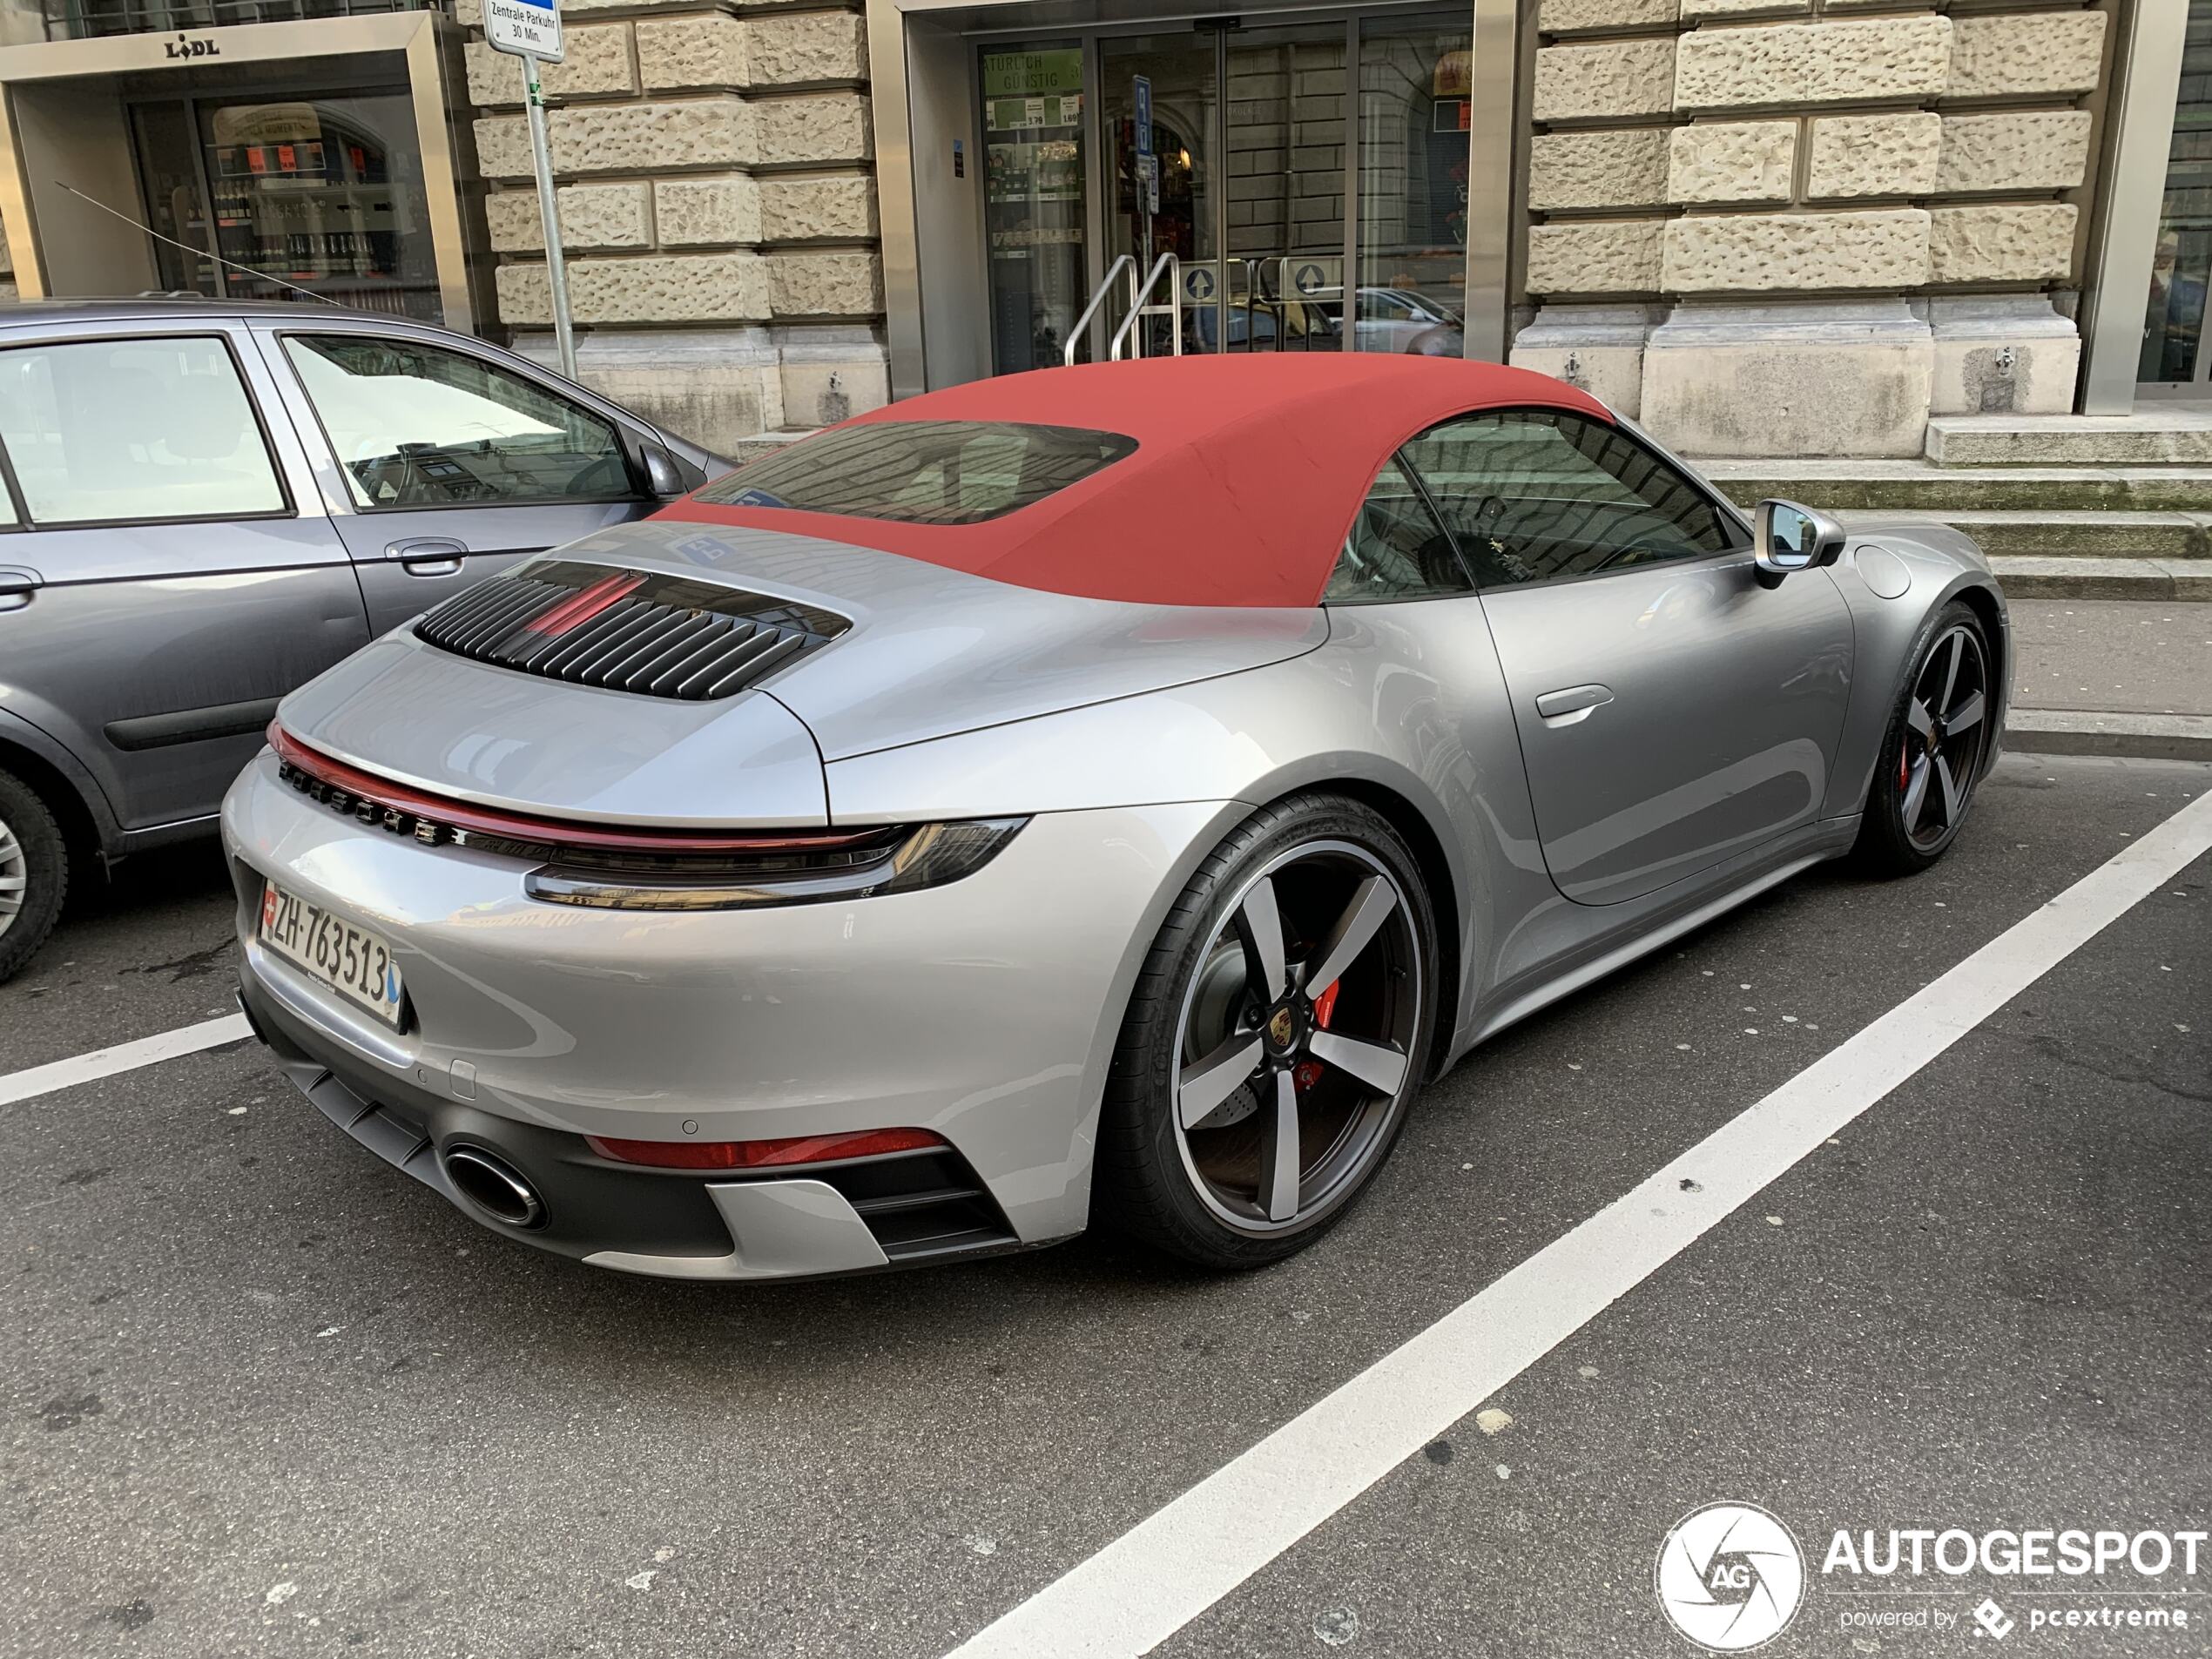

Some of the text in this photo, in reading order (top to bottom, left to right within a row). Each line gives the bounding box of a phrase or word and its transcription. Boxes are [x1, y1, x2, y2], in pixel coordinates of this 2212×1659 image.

[492, 2, 555, 30] Zentrale Parkuhr
[512, 24, 541, 42] 30 Min.
